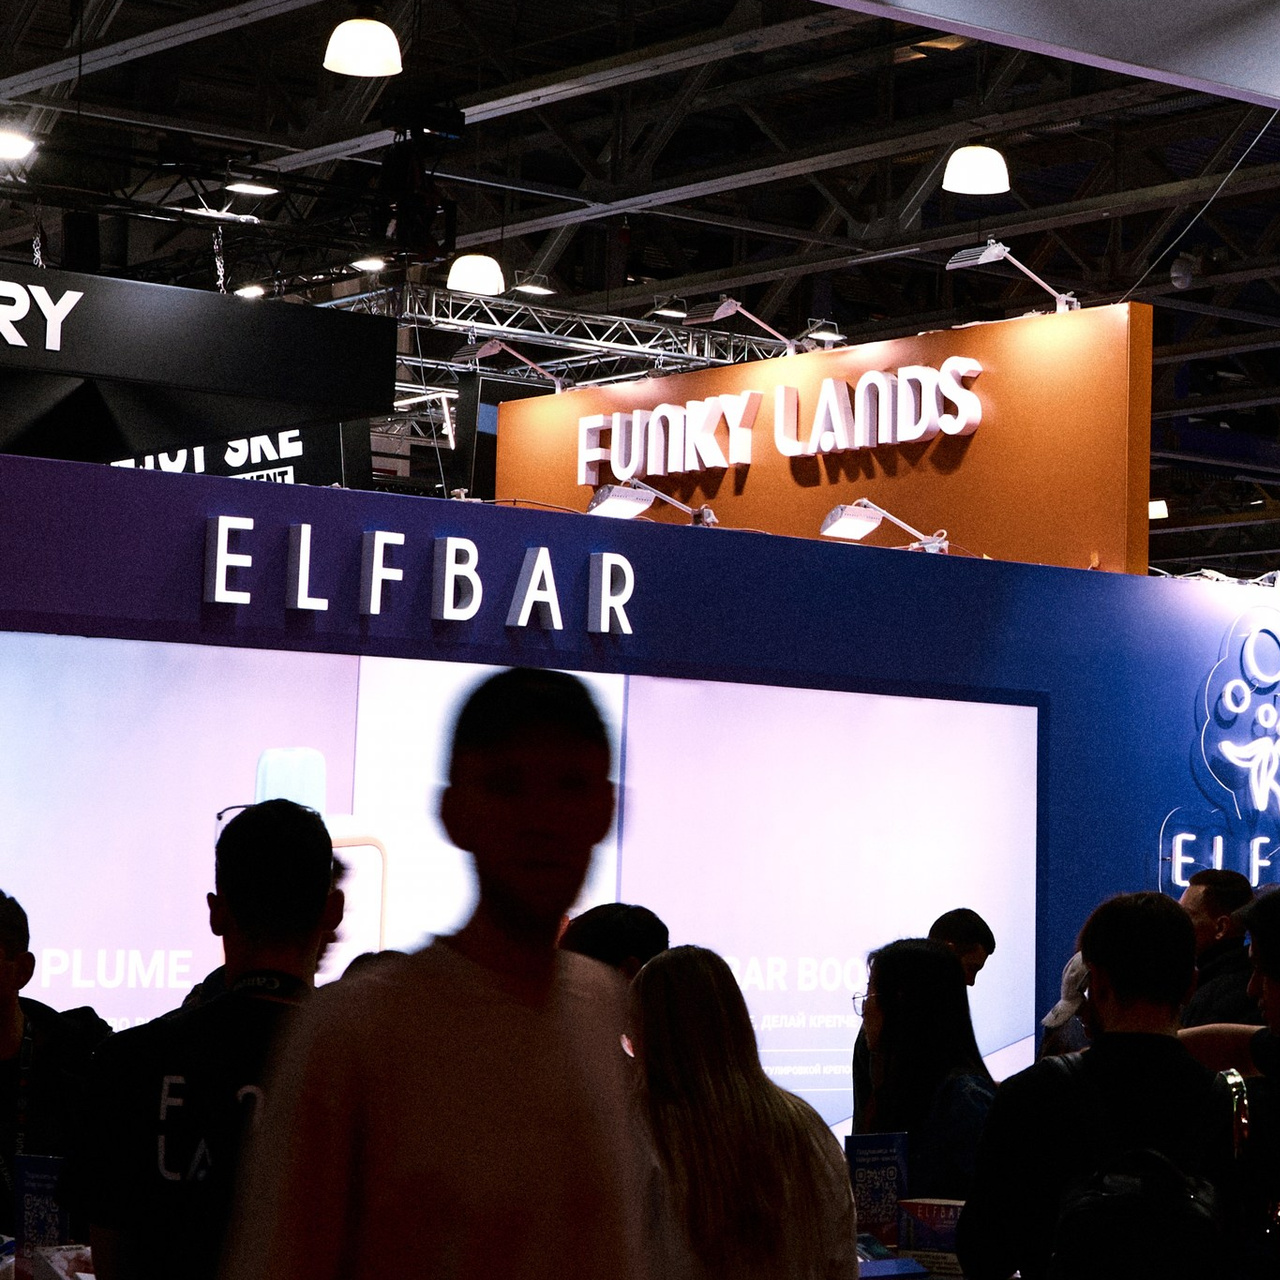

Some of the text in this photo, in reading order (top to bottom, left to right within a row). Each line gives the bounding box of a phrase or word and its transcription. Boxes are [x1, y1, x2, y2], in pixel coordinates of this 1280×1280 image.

[578, 356, 984, 486] FUNKY LANDS
[206, 515, 636, 635] ELFBAR
[41, 948, 193, 989] PLUME
[761, 1011, 806, 1031] ДЕЛАЙ
